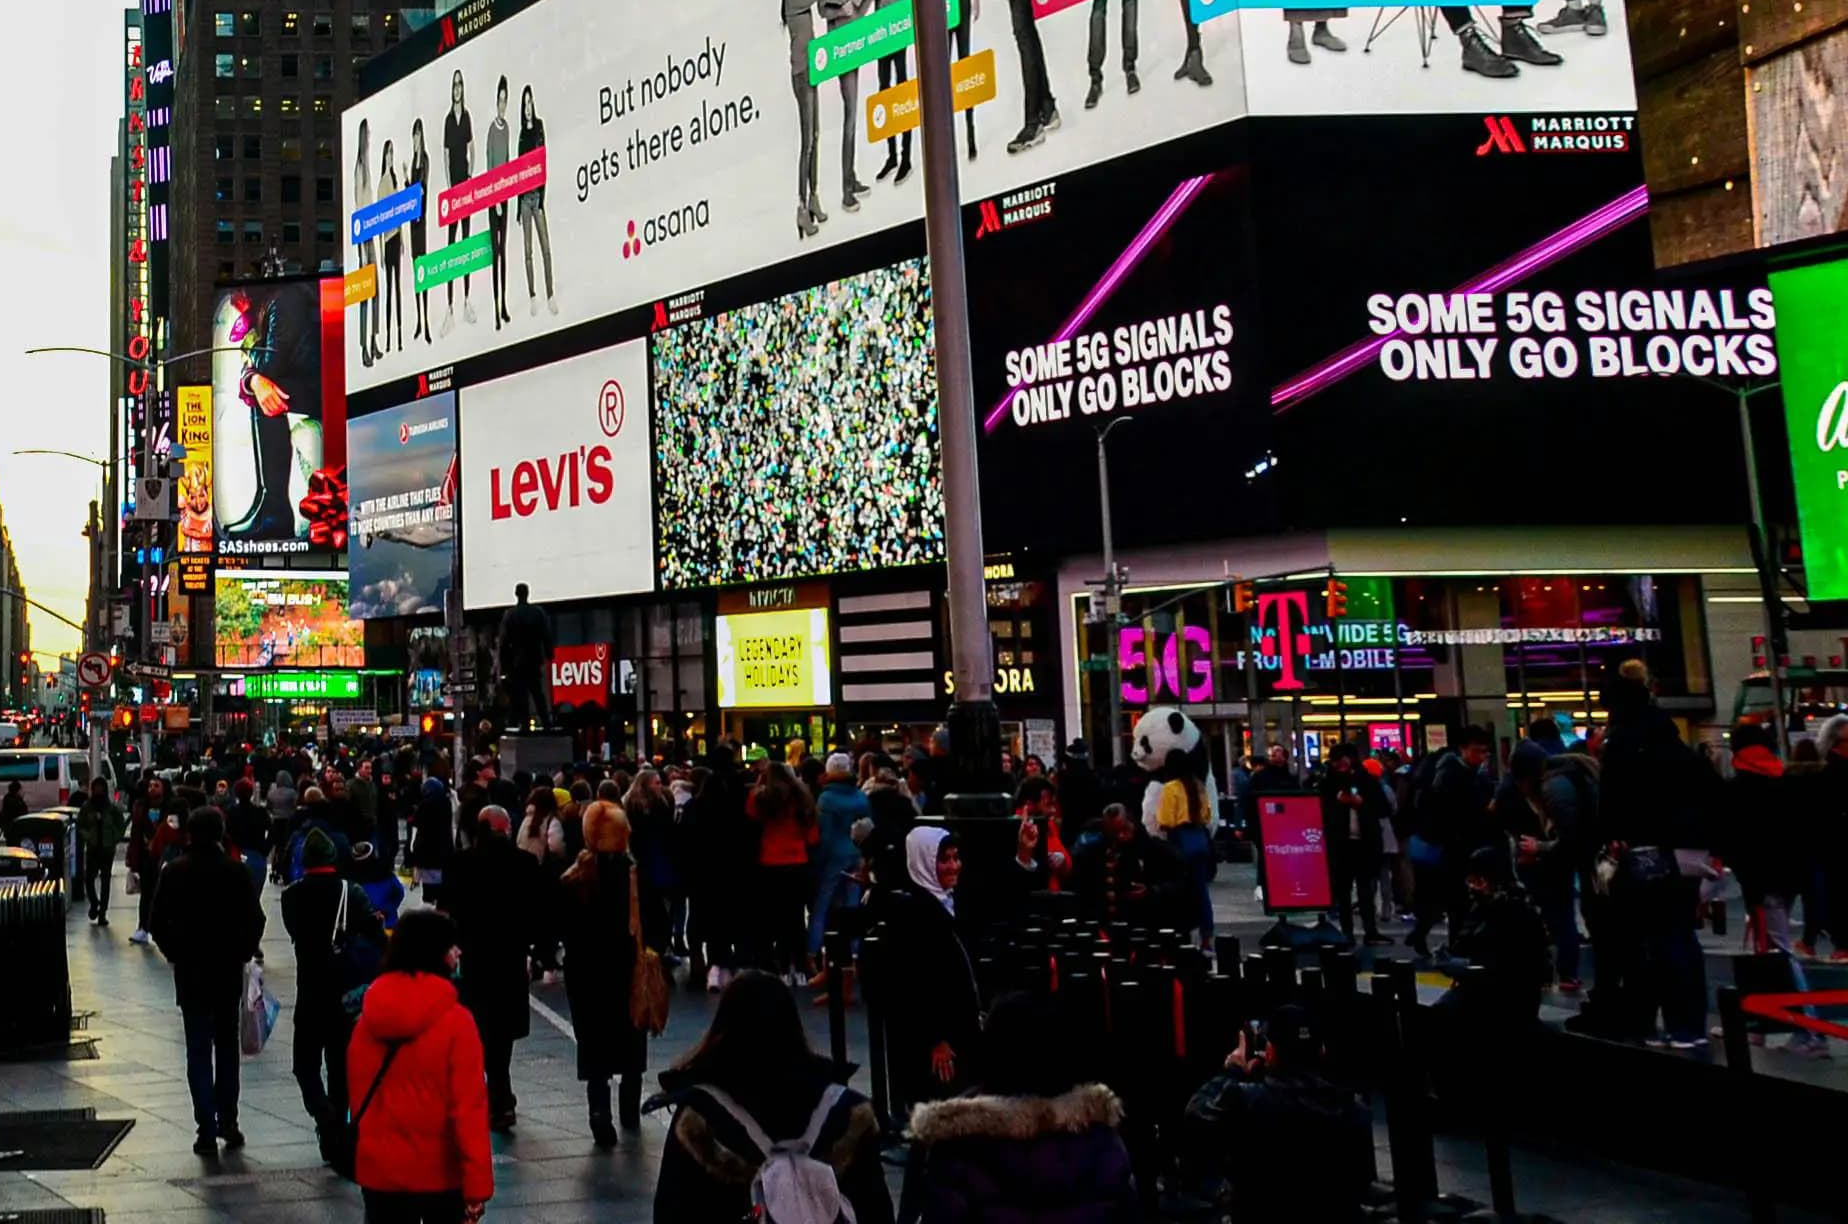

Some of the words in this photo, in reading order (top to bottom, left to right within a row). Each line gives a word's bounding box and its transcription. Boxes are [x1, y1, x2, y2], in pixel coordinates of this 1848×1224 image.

[458, 9, 492, 38] MARQUIS
[833, 37, 866, 60] Partner
[867, 26, 888, 46] with
[888, 14, 912, 37] local
[599, 80, 636, 125] But
[640, 36, 726, 108] nobody
[1531, 115, 1636, 132] MARRIOTT
[576, 153, 620, 203] gets
[626, 127, 683, 171] there
[689, 93, 761, 146] alone.
[1533, 133, 1626, 150] MARQUIS
[1002, 182, 1057, 208] MARRIOTT
[643, 197, 711, 246] asana
[1003, 200, 1052, 225] MARQUIS
[669, 291, 706, 312] MARRIOTT
[1366, 291, 1494, 337] SOME
[1506, 291, 1566, 334] 5G
[1576, 288, 1776, 332] SIGNALS
[1005, 338, 1072, 389] SOME
[1075, 332, 1110, 372] 5G
[1114, 305, 1234, 365] SIGNALS
[1380, 338, 1498, 380] ONLY
[1509, 337, 1579, 380] GO
[1589, 334, 1778, 378] BLOCKS
[1011, 378, 1074, 428] ONLY
[1078, 372, 1118, 413] GO
[1121, 349, 1233, 405] BLOCKS
[182, 412, 207, 427] LION
[186, 401, 203, 413] THE
[181, 428, 210, 445] KING
[218, 540, 310, 554] SASshoes.com
[1119, 625, 1214, 703] 5G
